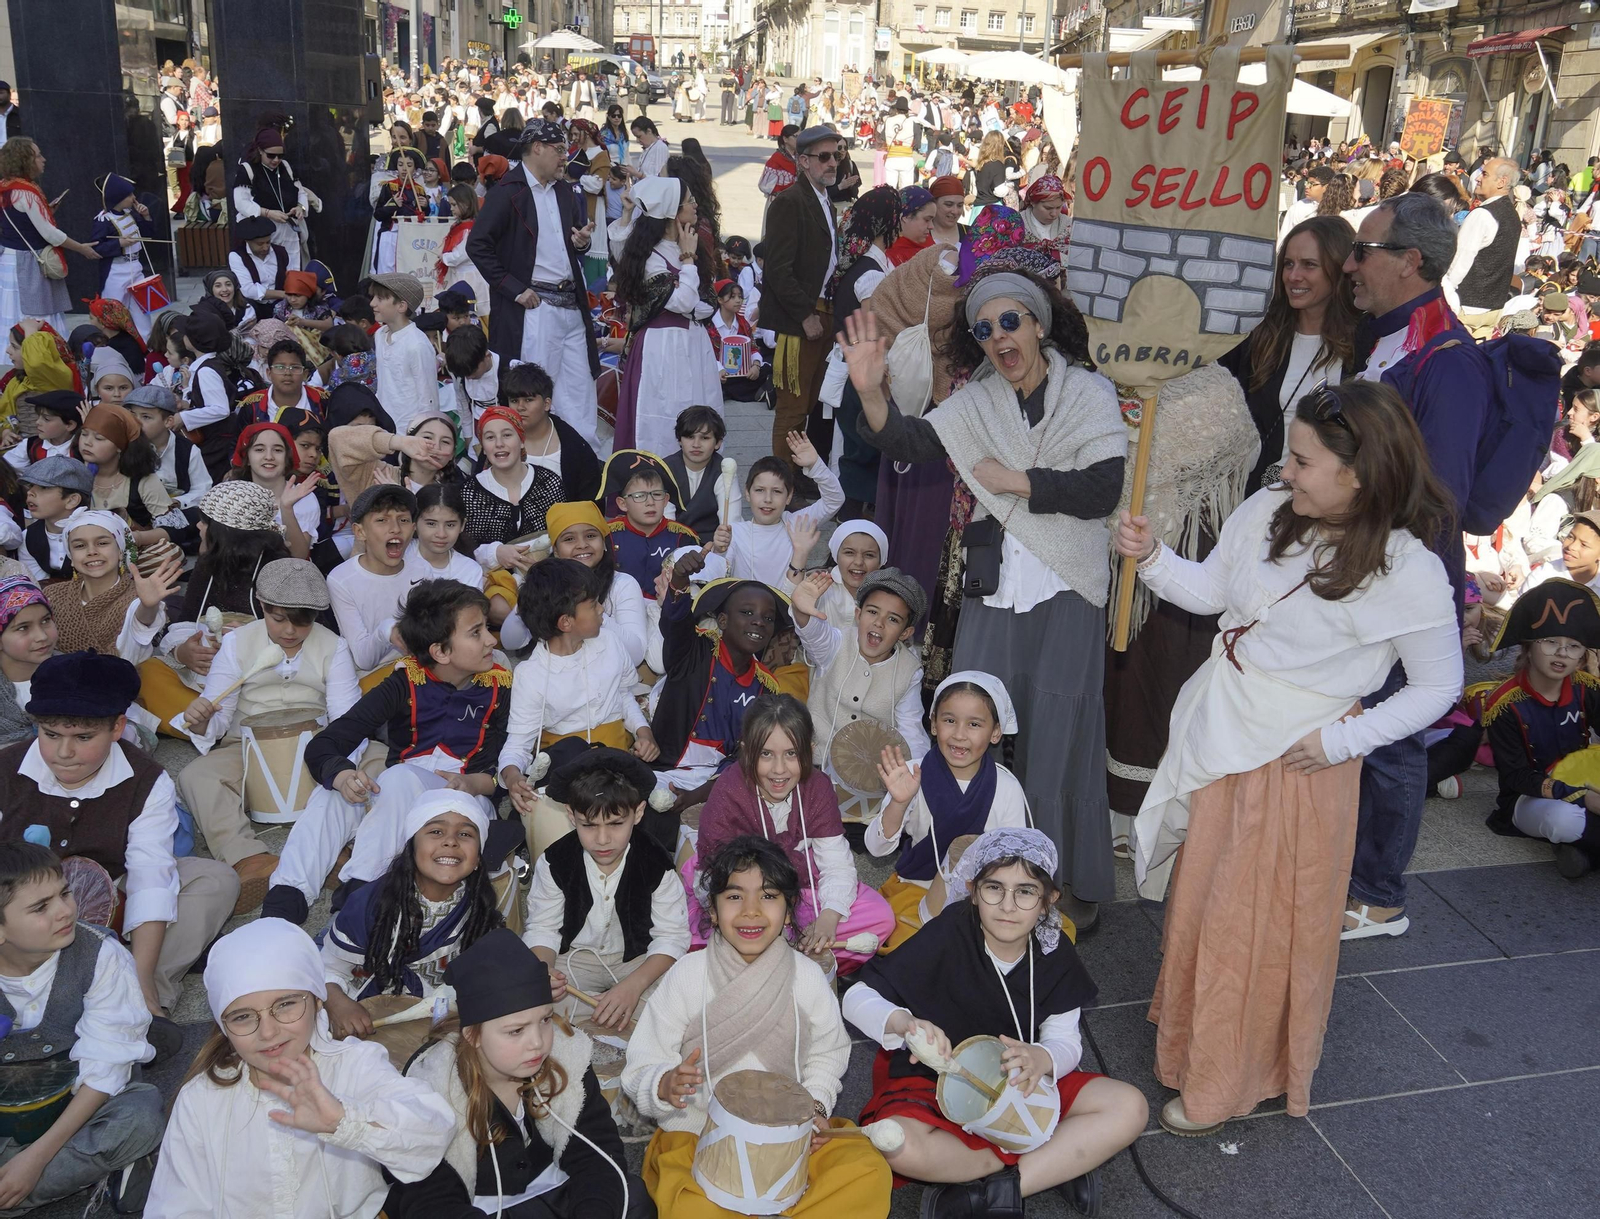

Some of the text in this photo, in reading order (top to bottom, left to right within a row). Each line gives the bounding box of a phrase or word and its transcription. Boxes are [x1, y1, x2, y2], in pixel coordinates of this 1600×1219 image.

[1120, 84, 1259, 140] CEIP
[1418, 101, 1441, 111] CPR
[1407, 110, 1447, 126] ATALAYA
[1401, 122, 1443, 151] CANTABRIA
[1083, 156, 1272, 210] O SELLO
[411, 239, 438, 250] CEIP
[422, 252, 428, 263] A
[1096, 343, 1208, 369] CABRAL
[650, 546, 671, 558] N
[1531, 598, 1585, 630] N
[733, 692, 756, 707] N
[457, 704, 484, 722] N
[1560, 710, 1580, 726] N
